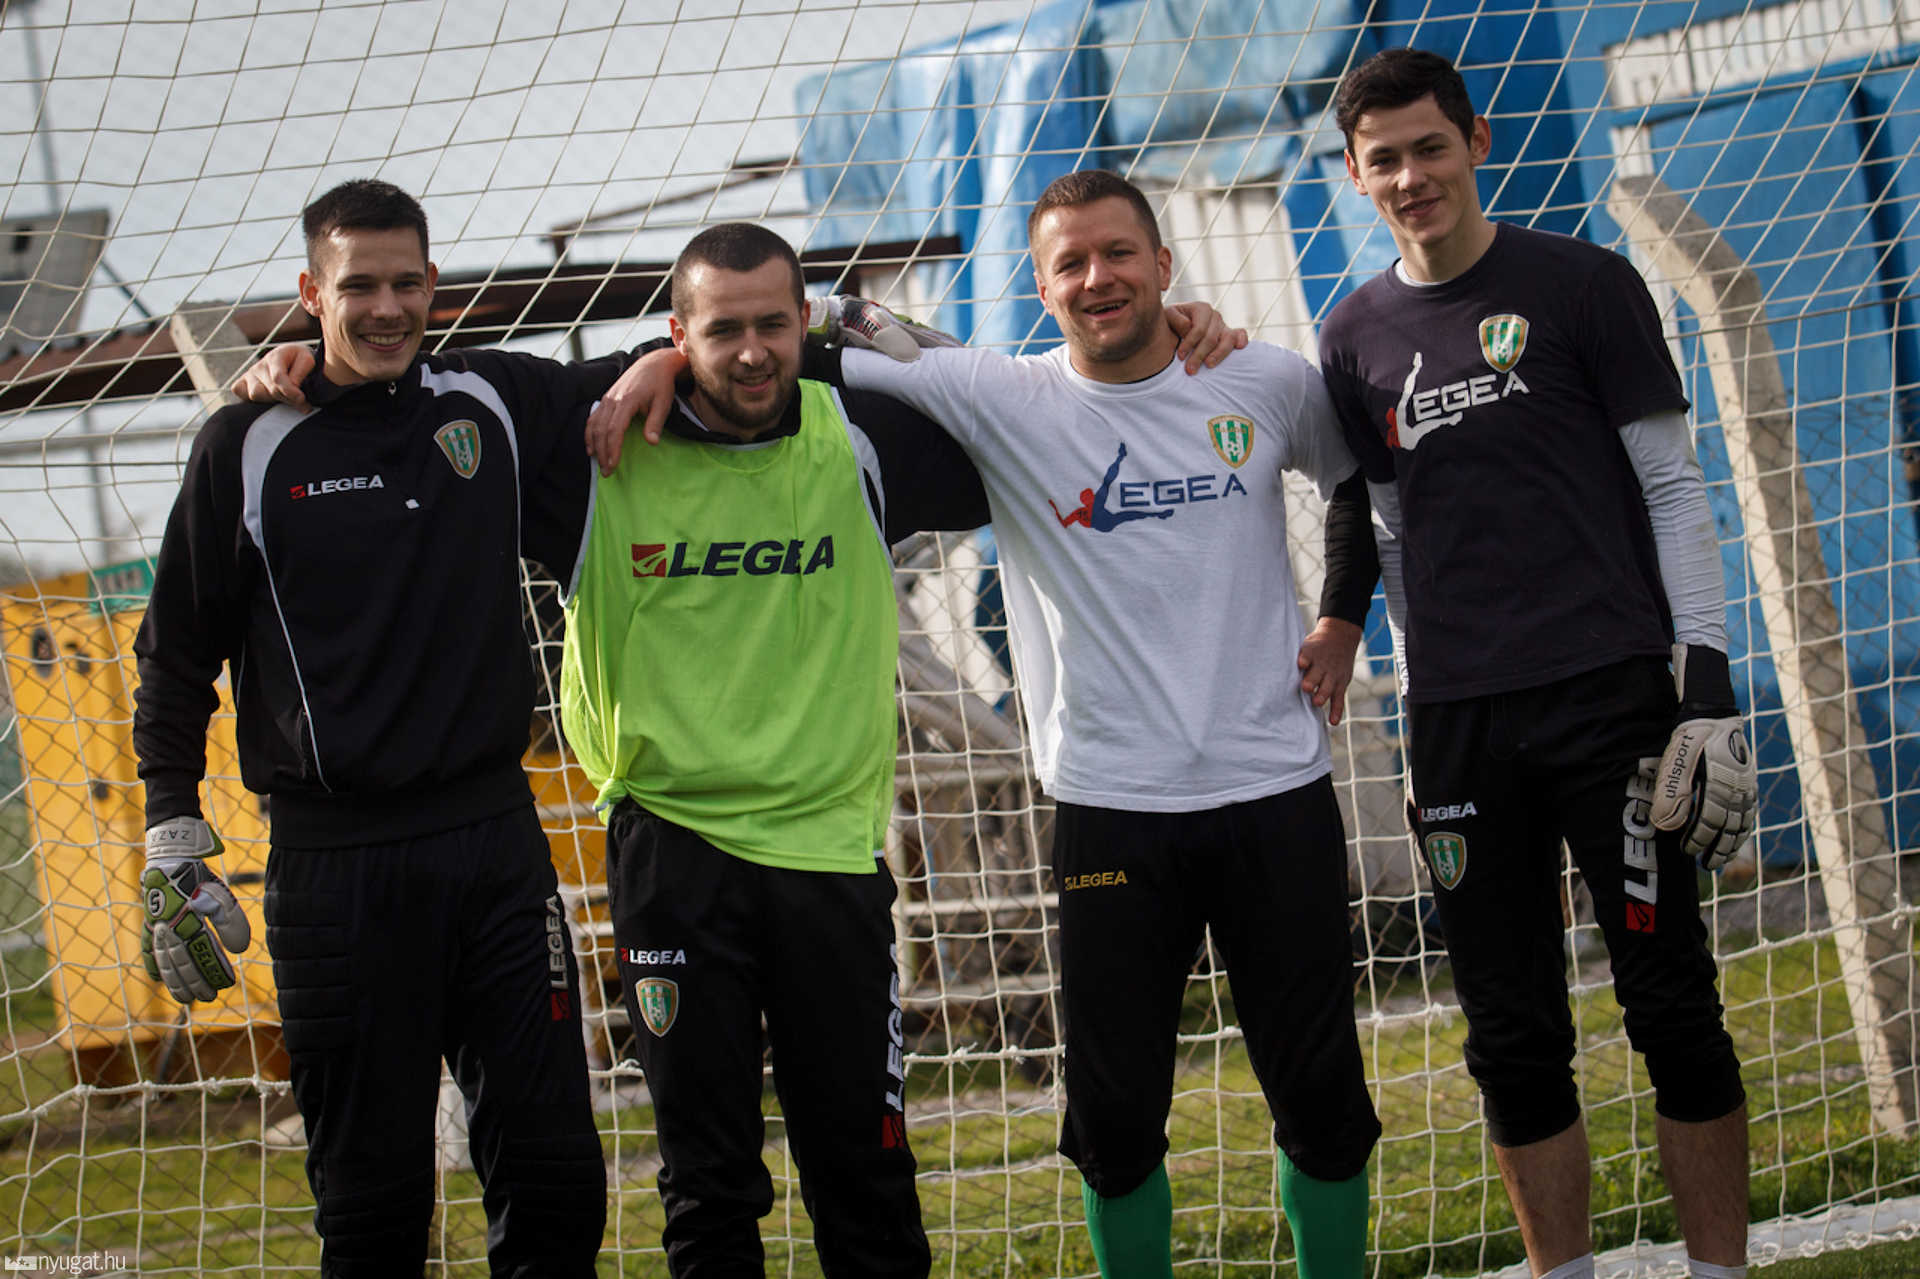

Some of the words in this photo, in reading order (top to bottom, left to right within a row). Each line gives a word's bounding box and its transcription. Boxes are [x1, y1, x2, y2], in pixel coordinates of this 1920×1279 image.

[307, 474, 385, 497] LEGEA
[667, 535, 835, 578] LEGEA
[1664, 733, 1695, 800] uhlsport
[1421, 801, 1478, 822] LEGEA
[1072, 870, 1129, 889] LEGEA
[545, 894, 569, 989] LEGEA
[629, 948, 687, 965] LEGEA
